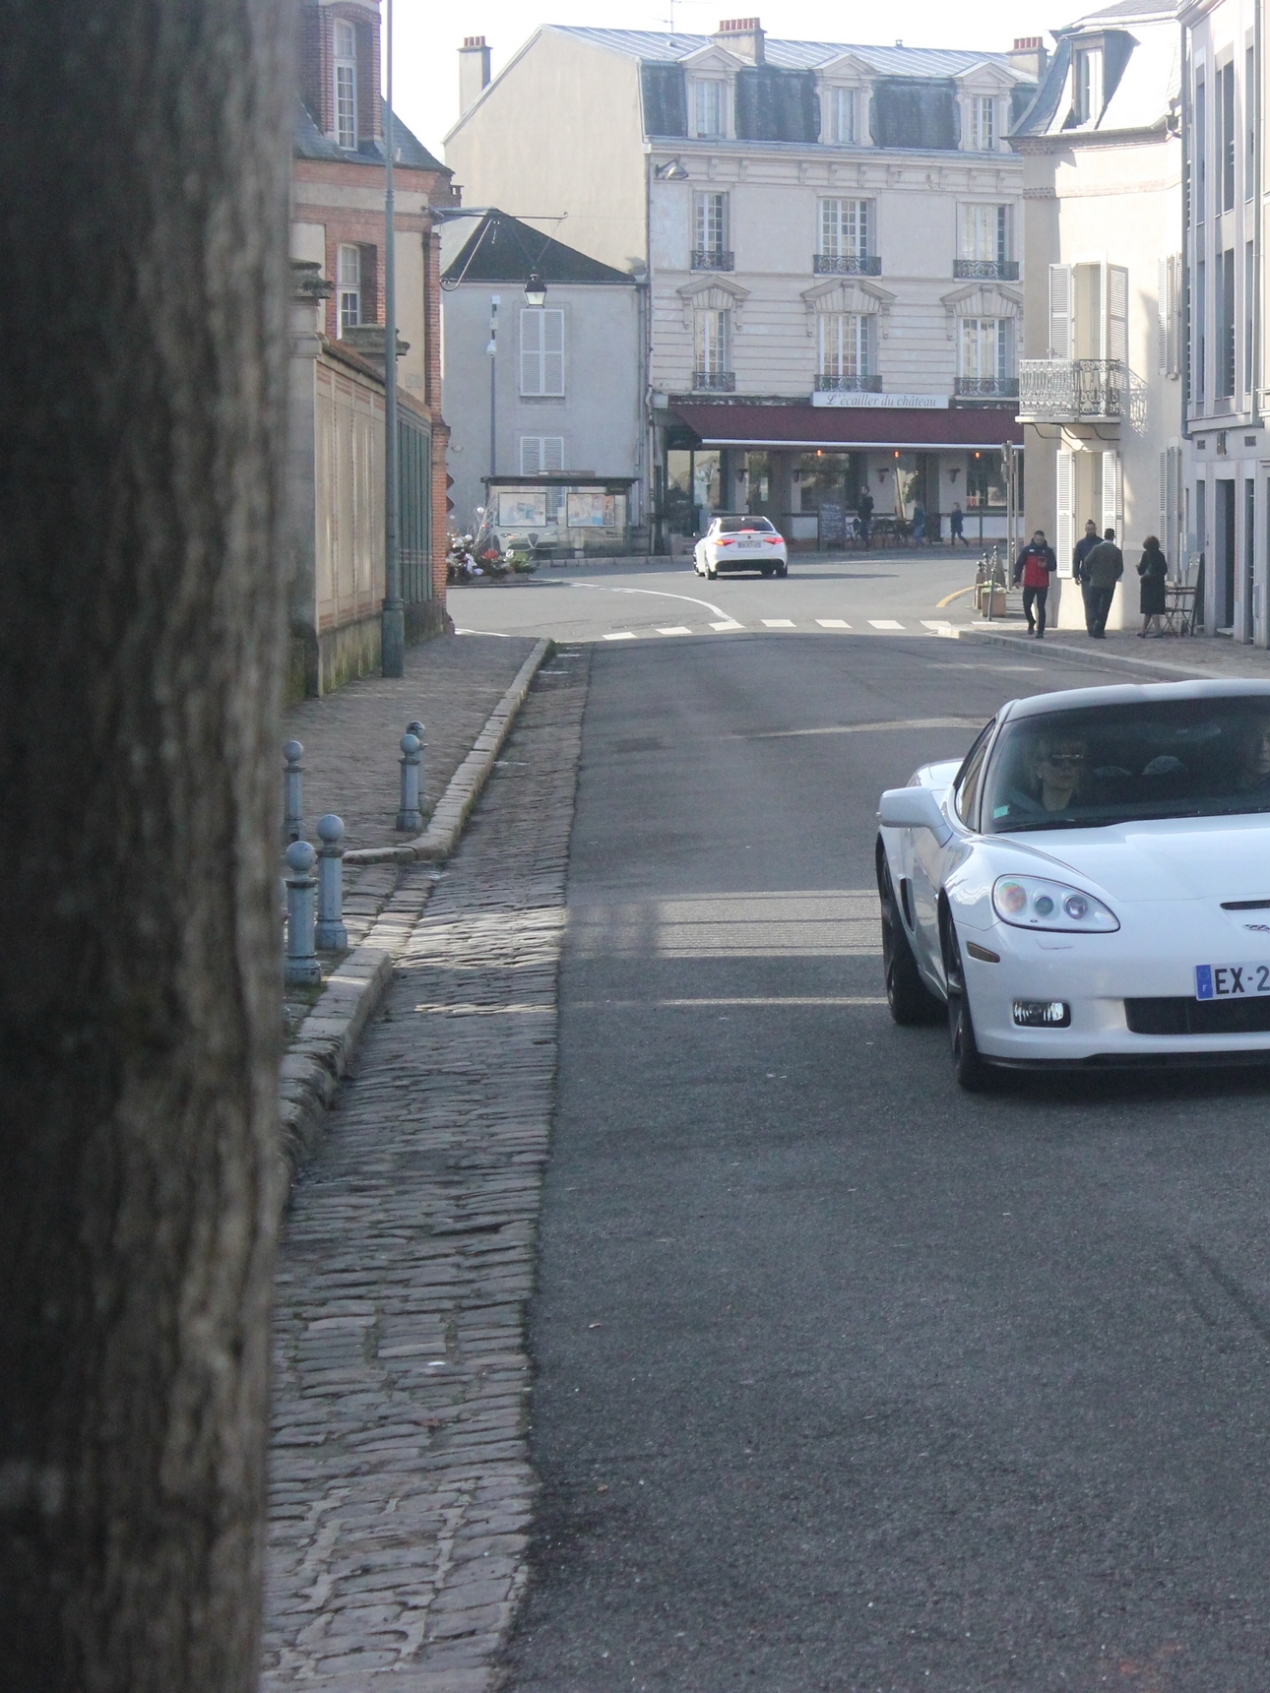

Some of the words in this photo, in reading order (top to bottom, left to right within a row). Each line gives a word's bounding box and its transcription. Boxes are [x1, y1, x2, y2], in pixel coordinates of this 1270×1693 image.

[826, 393, 877, 406] L'écailler
[880, 395, 895, 407] du
[896, 396, 937, 407] château
